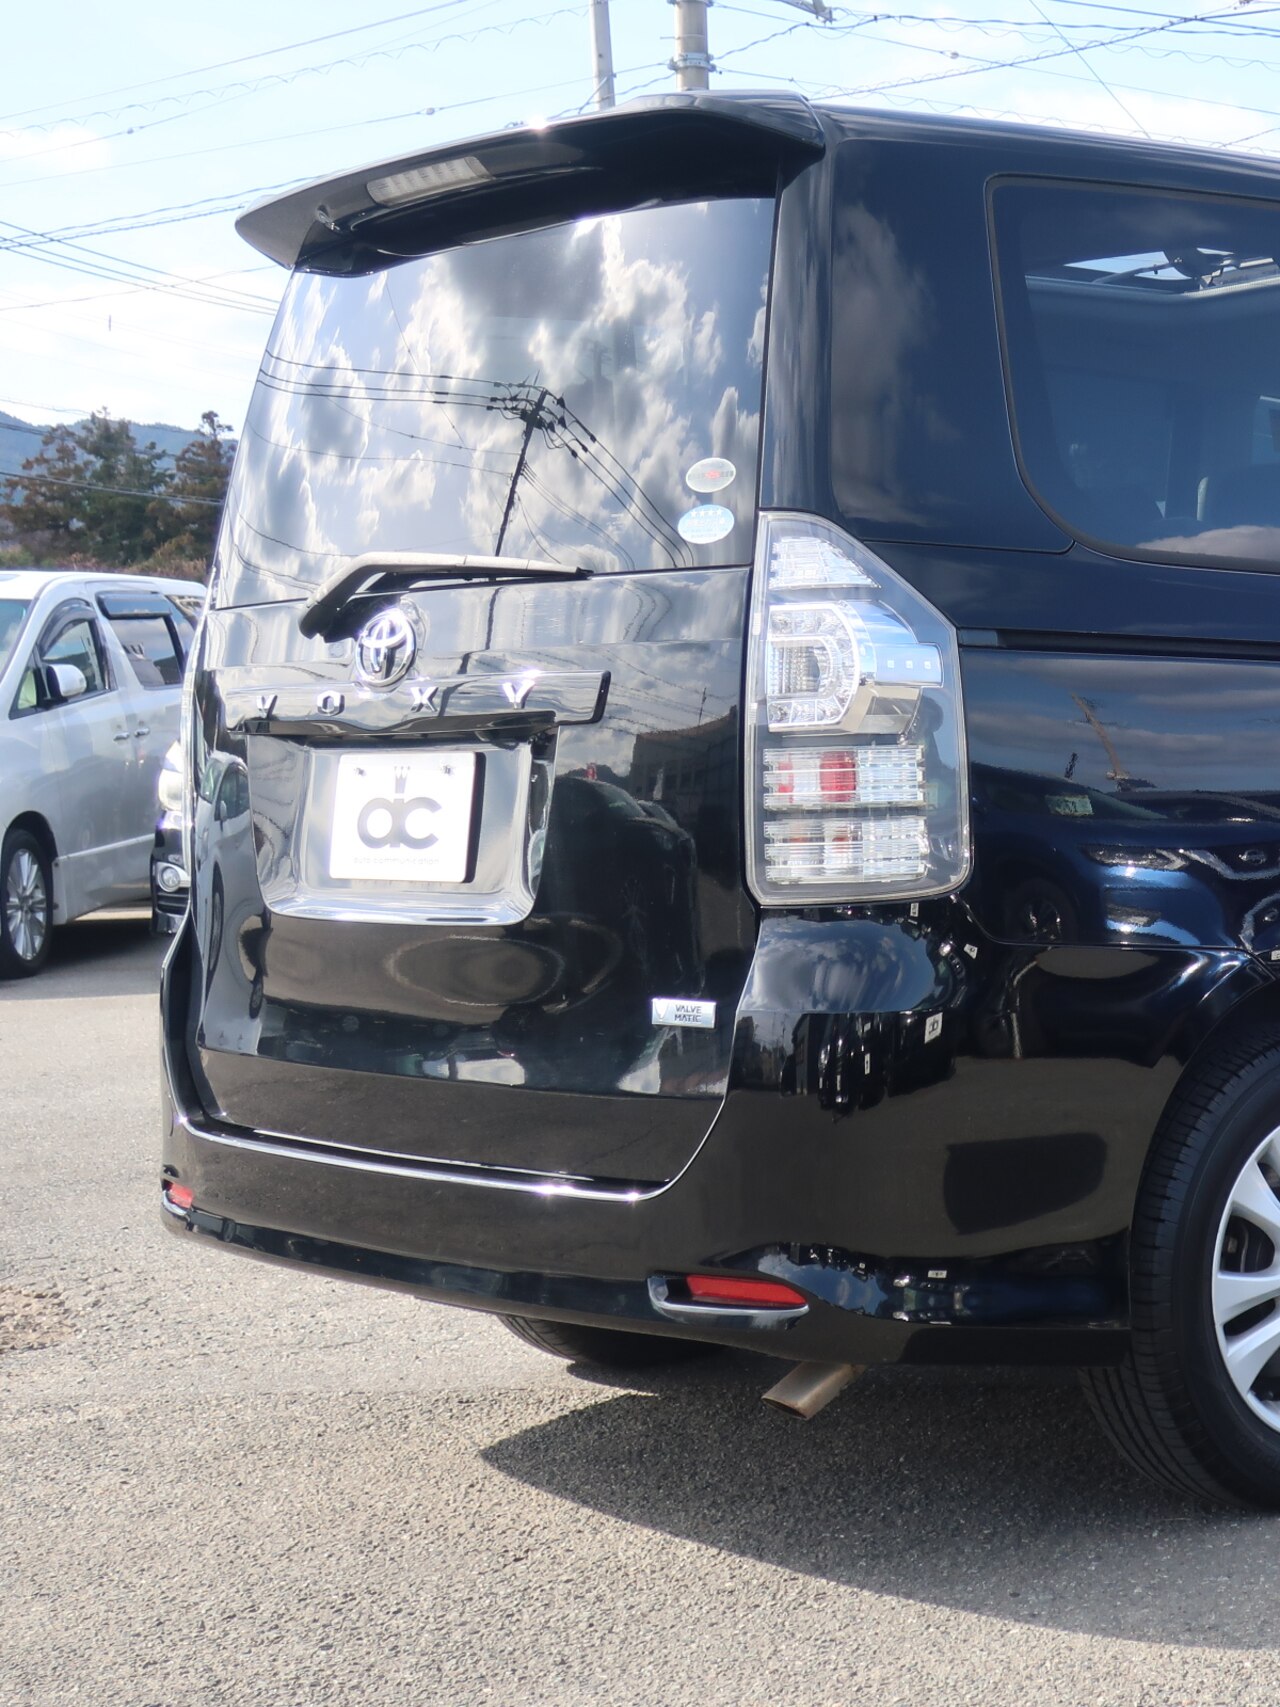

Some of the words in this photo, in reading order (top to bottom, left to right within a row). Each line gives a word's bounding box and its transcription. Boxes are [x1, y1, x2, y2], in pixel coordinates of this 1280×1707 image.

[256, 679, 536, 717] VOXY
[675, 1004, 702, 1013] VALVE
[674, 1014, 702, 1022] MATIC
